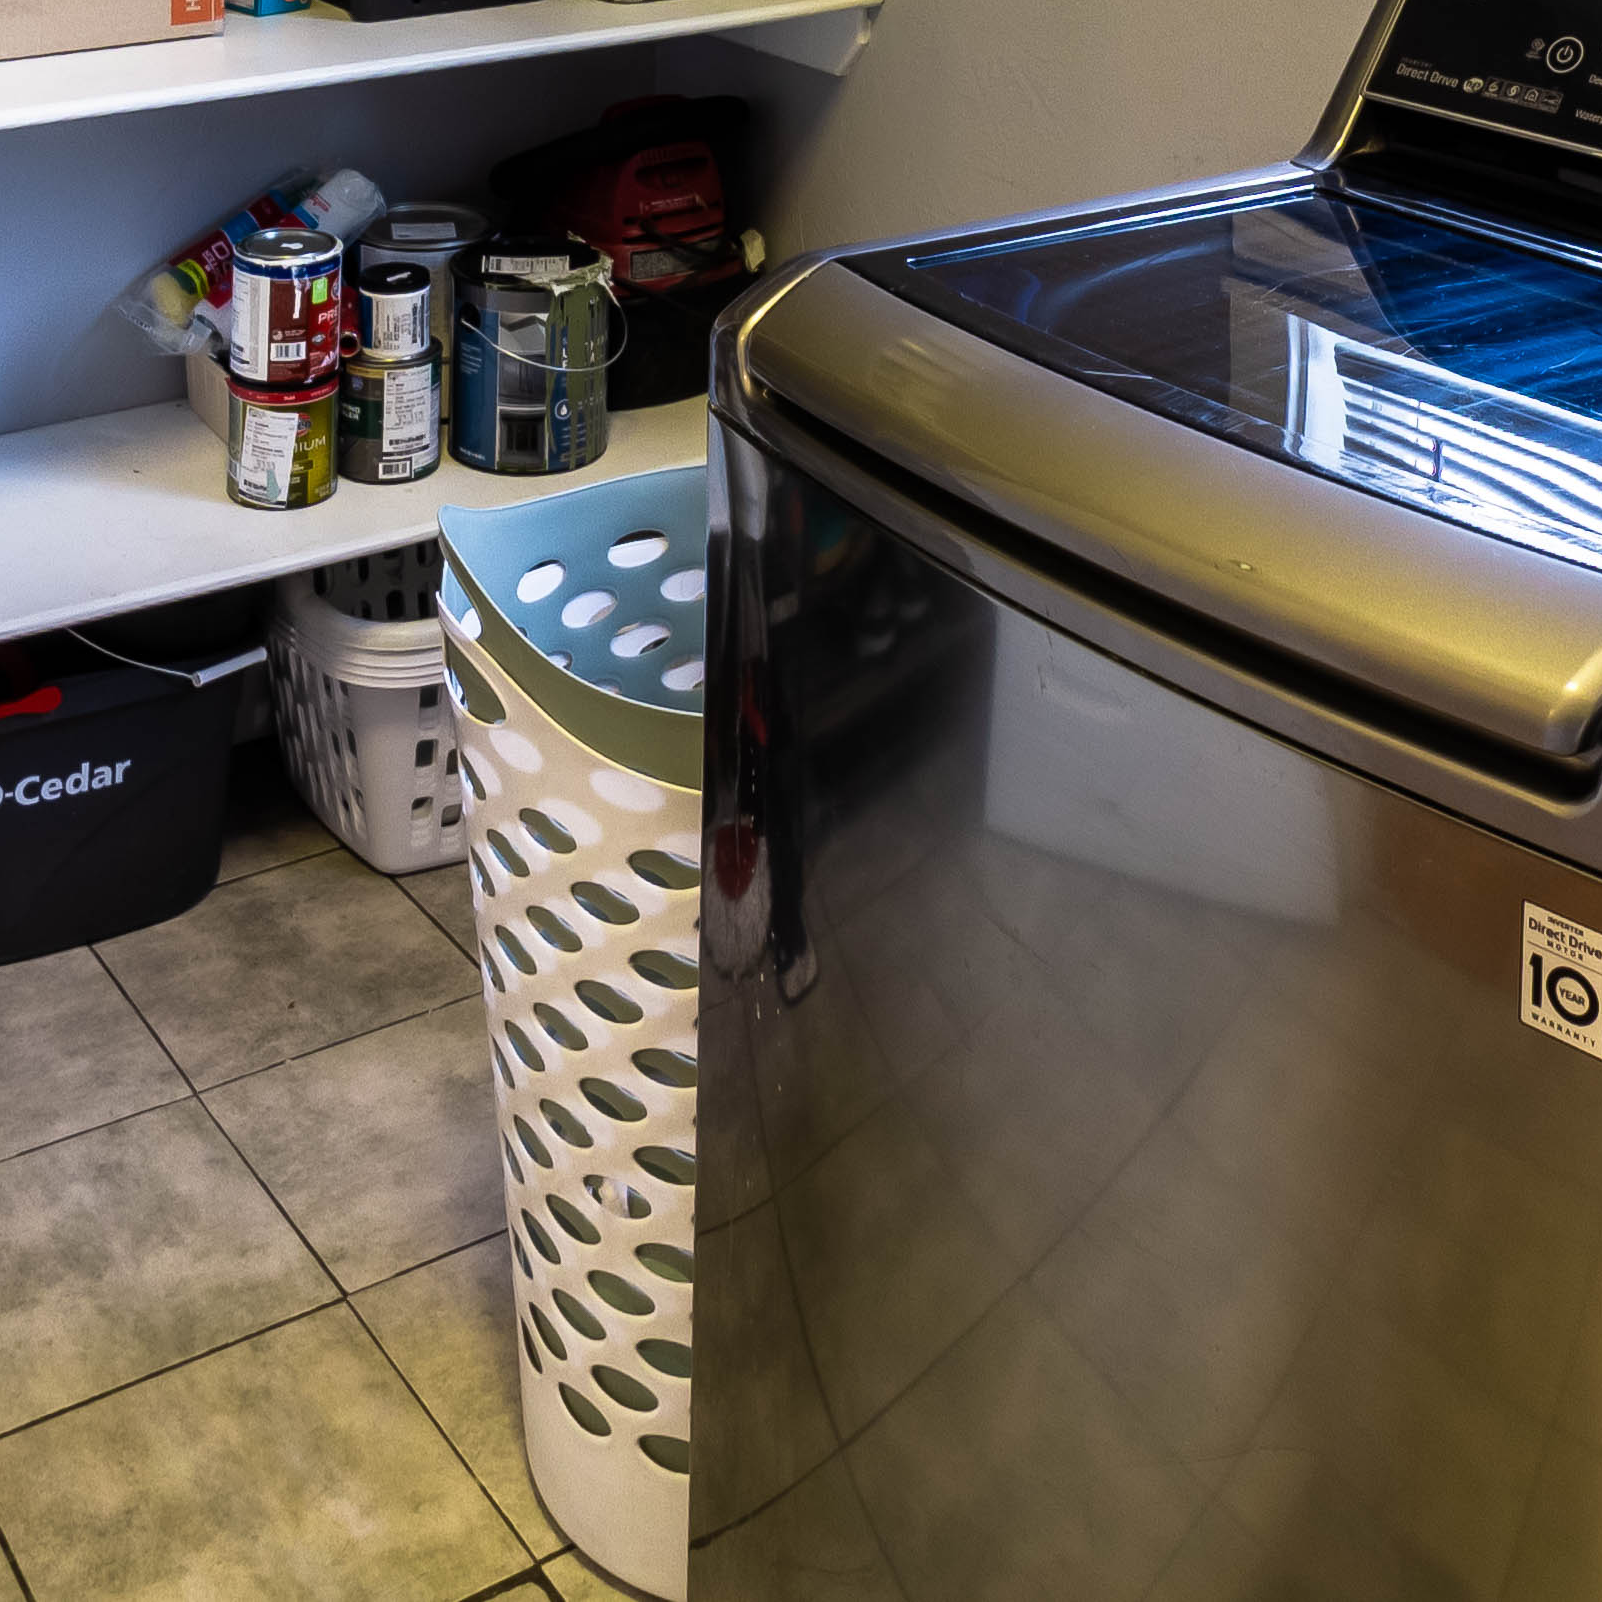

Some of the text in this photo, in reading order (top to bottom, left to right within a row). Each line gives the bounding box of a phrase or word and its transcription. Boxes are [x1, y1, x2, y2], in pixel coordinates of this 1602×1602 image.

[1396, 63, 1460, 88] Direct Drive
[1528, 917, 1566, 944] Direct
[1547, 916, 1585, 937] INVERTER
[1547, 940, 1584, 961] MOTOR
[1529, 952, 1600, 1027] 10
[1559, 985, 1586, 1007] YEAR
[1531, 1012, 1596, 1048] WARRANTY
